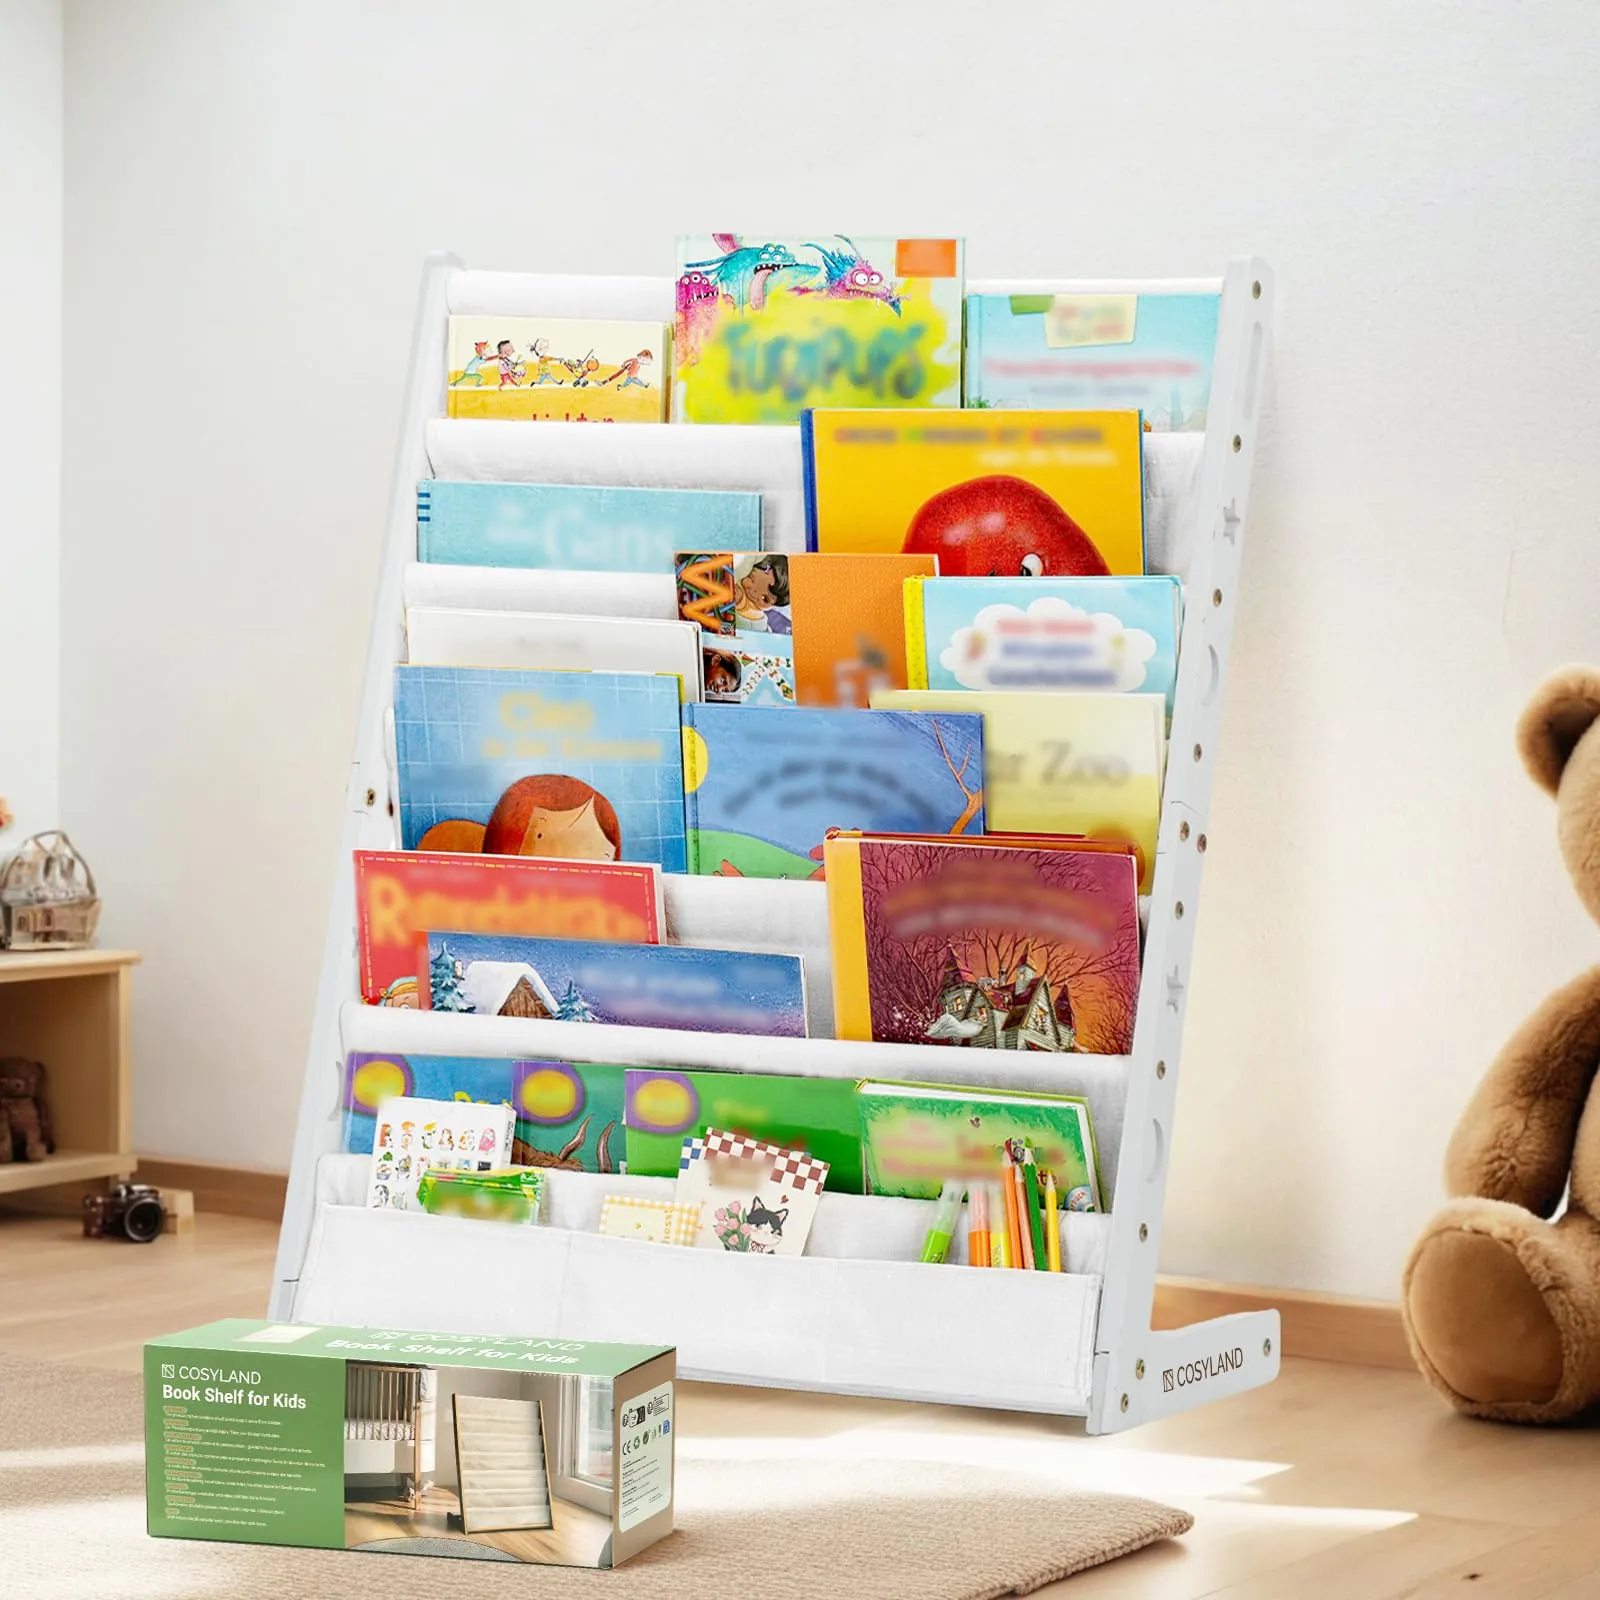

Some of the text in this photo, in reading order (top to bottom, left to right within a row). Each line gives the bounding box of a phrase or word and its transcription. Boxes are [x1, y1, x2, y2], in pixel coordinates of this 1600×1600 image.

[325, 1339, 579, 1364] Book Shelf for Kids
[410, 1332, 585, 1351] COSYLAND
[178, 1366, 262, 1385] COSYLAND
[1176, 1347, 1244, 1387] COSYLAND
[162, 1384, 307, 1409] Book Shelf for Kids
